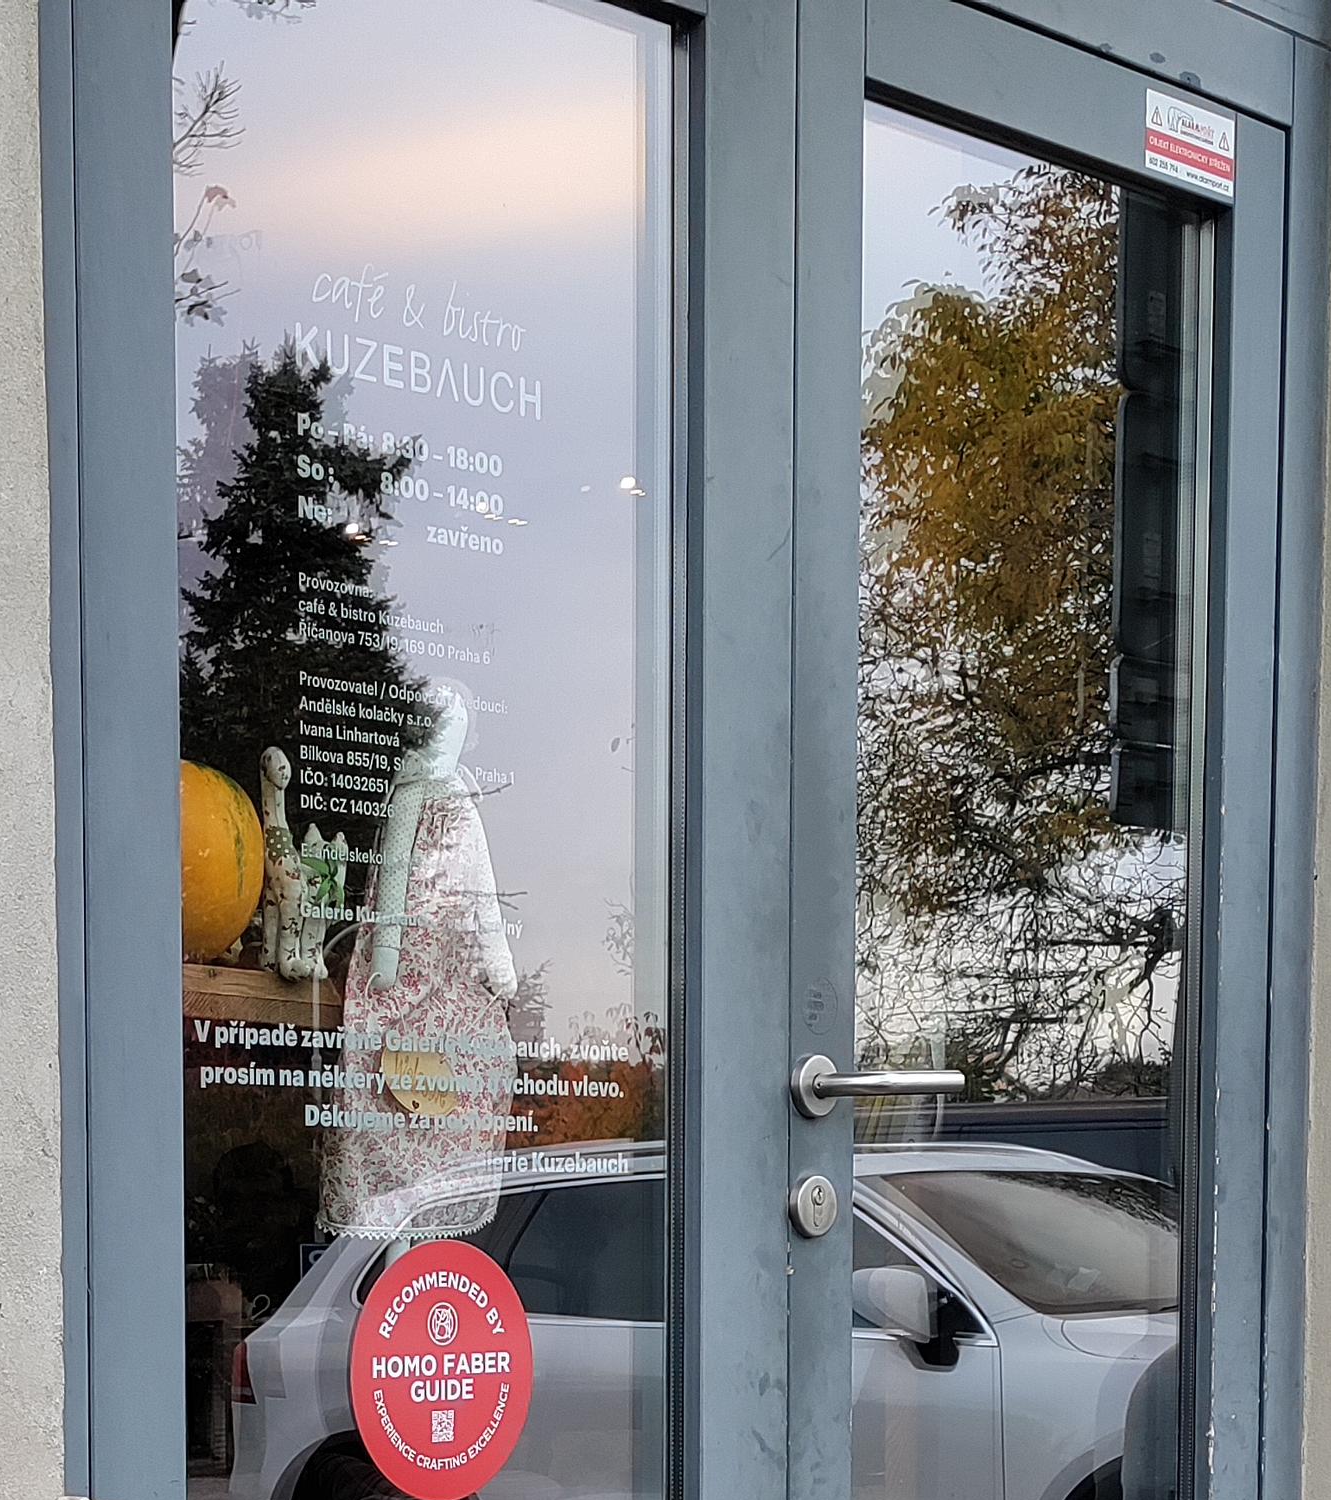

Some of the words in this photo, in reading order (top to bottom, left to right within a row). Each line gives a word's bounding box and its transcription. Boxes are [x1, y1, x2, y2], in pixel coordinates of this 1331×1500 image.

[311, 262, 386, 324] café
[402, 285, 425, 328] &
[443, 281, 526, 352] bistro
[293, 321, 541, 421] KUZEBAUCH
[297, 412, 324, 440] Po
[343, 422, 374, 450] Pá:
[382, 432, 429, 462] 8:30
[447, 446, 503, 477] 18:00
[380, 471, 429, 500] 8:00
[447, 485, 504, 516] 14:00
[298, 495, 333, 524] Ne:
[427, 525, 504, 556] zavřeno
[298, 572, 374, 599] Provozovna:
[298, 599, 326, 616] café
[328, 603, 338, 617] &
[340, 602, 376, 624] bistro
[378, 610, 444, 635] Kuzebauch
[299, 621, 355, 645] Říčanova
[358, 629, 402, 654] 753/19,
[404, 636, 425, 656] 169
[428, 641, 445, 658] 00
[447, 645, 481, 664] Praha
[482, 650, 491, 665] 6
[299, 670, 379, 698] Provozovatel
[299, 695, 356, 718] Andělské
[406, 714, 435, 730] s.r.o.
[299, 720, 333, 738] Ivana
[335, 725, 400, 748] Linhartová
[299, 745, 344, 765] Bílkova
[346, 750, 391, 772] 855/19,
[475, 767, 507, 785] Praha
[510, 771, 516, 786] 1
[300, 769, 329, 788] IČO:
[331, 772, 390, 794] 14032651
[300, 794, 327, 812] DIČ:
[329, 798, 348, 815] CZ
[300, 904, 353, 923] Galerie
[194, 1020, 211, 1042] V
[214, 1020, 298, 1049] případě
[569, 1040, 629, 1062] zvoňte
[200, 1062, 275, 1088] prosím
[279, 1069, 304, 1087] na
[308, 1064, 385, 1094] některý
[570, 1075, 625, 1098] vlevo.
[304, 1104, 406, 1130] Děkujeme
[409, 1113, 431, 1129] za
[532, 1152, 629, 1174] Kuzebauch
[378, 1271, 489, 1339] RECOMMENDED
[485, 1307, 505, 1335] BY
[372, 1354, 437, 1379] HOMO
[443, 1351, 510, 1376] FABER
[410, 1378, 474, 1402] GUIDE
[374, 1389, 416, 1462] EXPERIENCE
[416, 1451, 468, 1471] CRAFTING
[467, 1382, 510, 1458] EXCELLENCE
